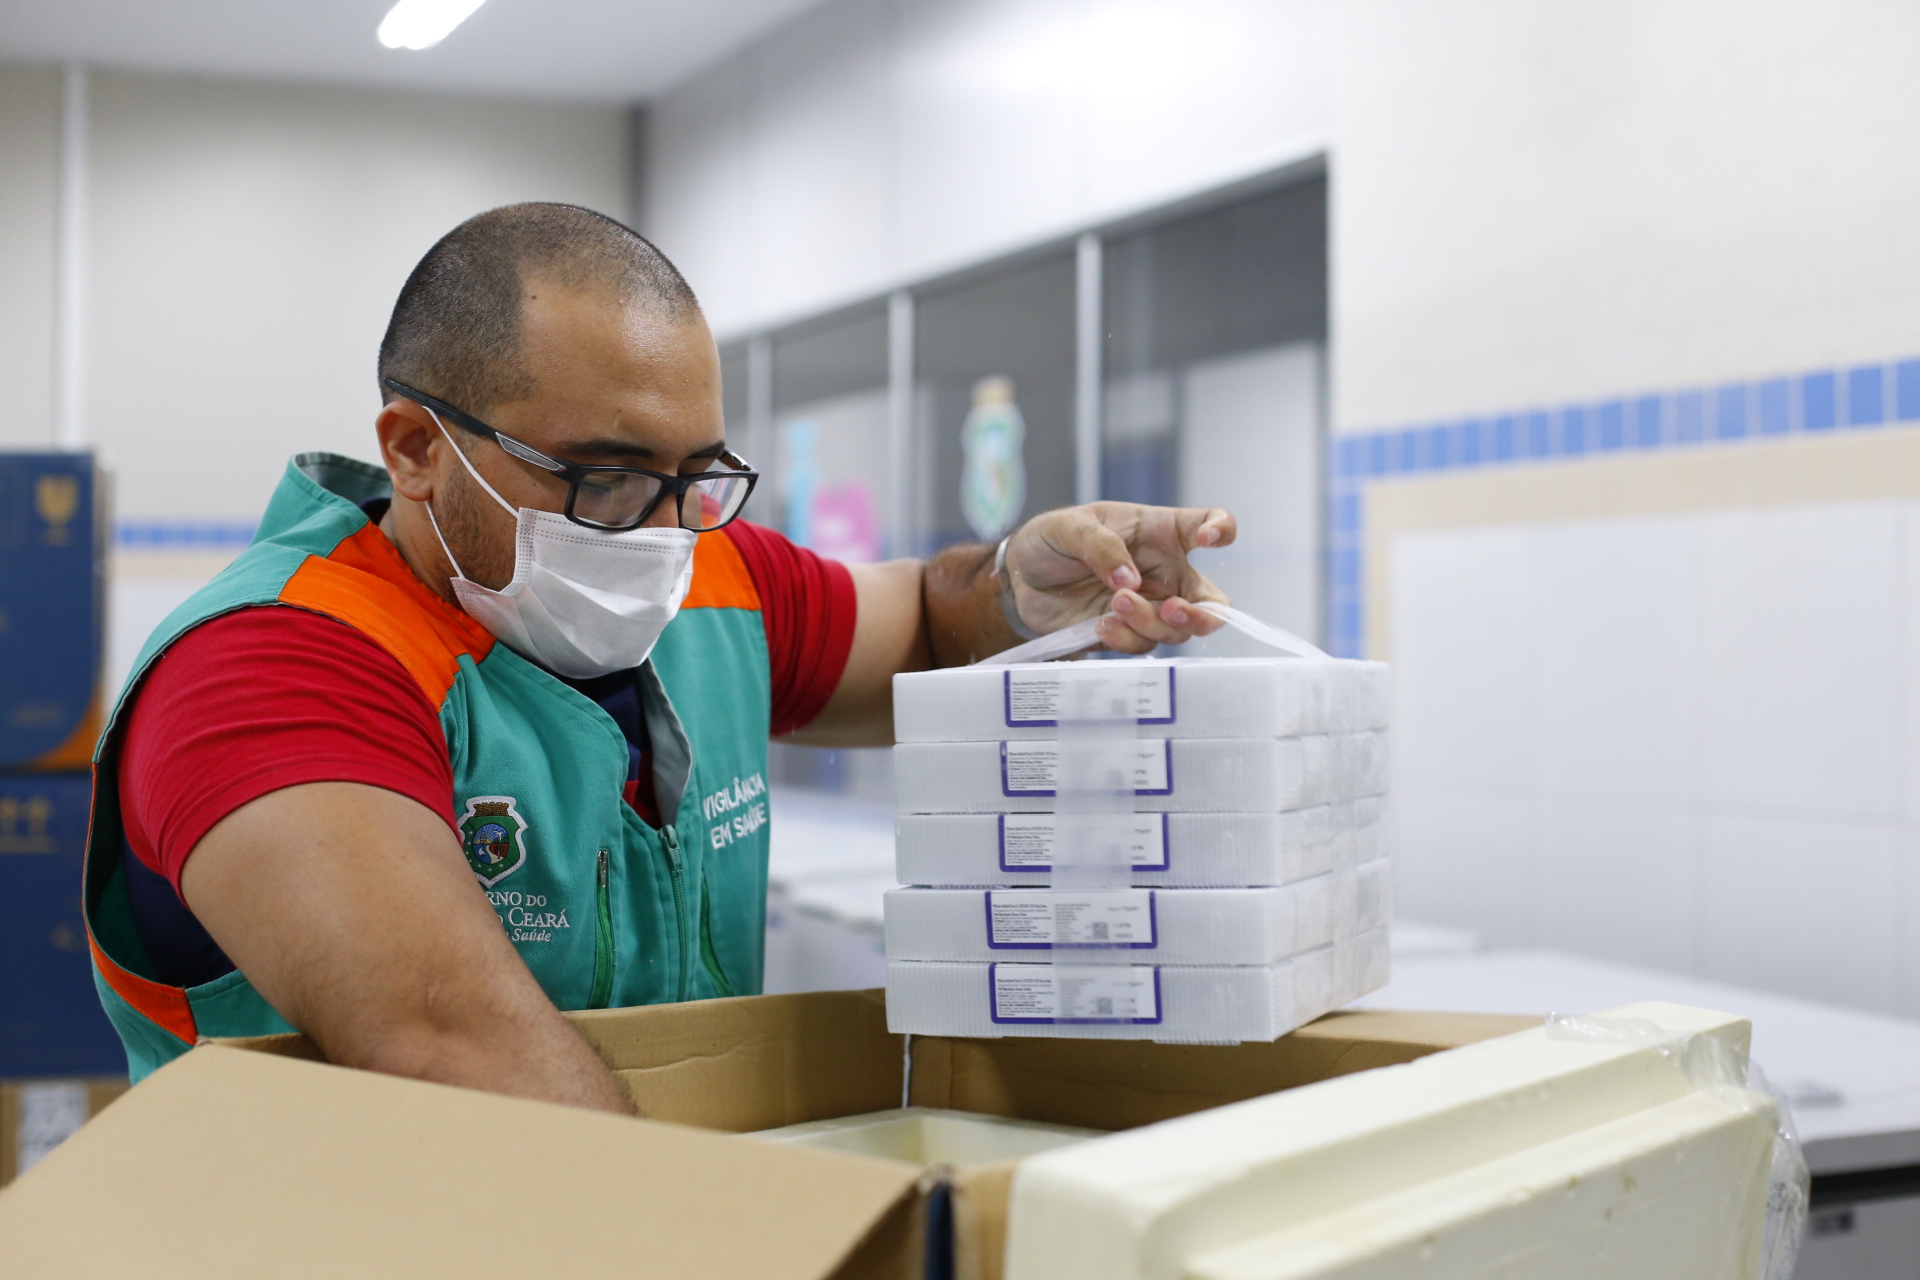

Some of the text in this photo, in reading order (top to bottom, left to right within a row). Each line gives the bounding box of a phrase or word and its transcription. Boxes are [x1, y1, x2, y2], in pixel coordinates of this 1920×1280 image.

[703, 772, 766, 820] VIGILÂNCIA
[711, 802, 767, 850] EM SAÚDE
[485, 891, 547, 907] RNO DO
[511, 928, 552, 942] Saúde
